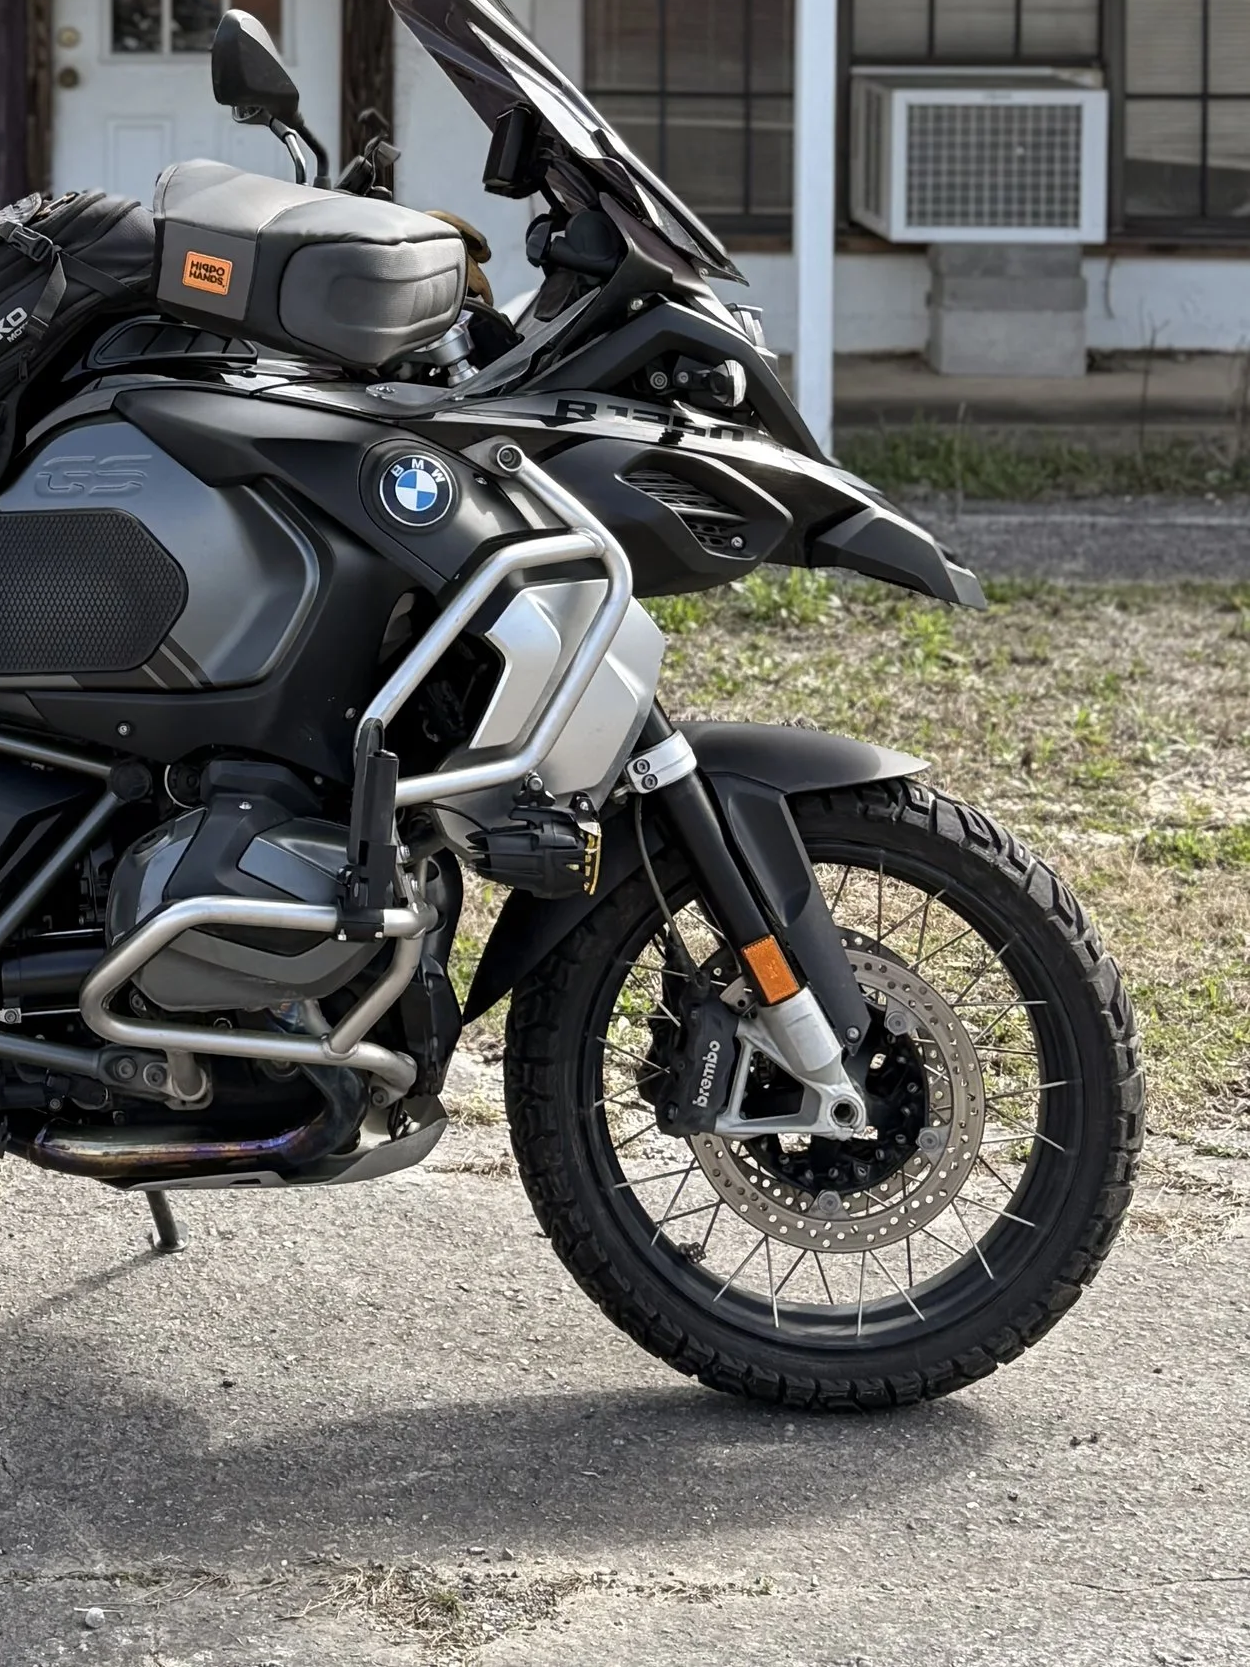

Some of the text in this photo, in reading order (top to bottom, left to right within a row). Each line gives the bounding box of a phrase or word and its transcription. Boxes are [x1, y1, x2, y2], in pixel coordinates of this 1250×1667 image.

[189, 259, 226, 277] HIPPO
[34, 455, 152, 497] GS
[390, 458, 446, 483] BMW
[692, 1040, 721, 1108] brembo
